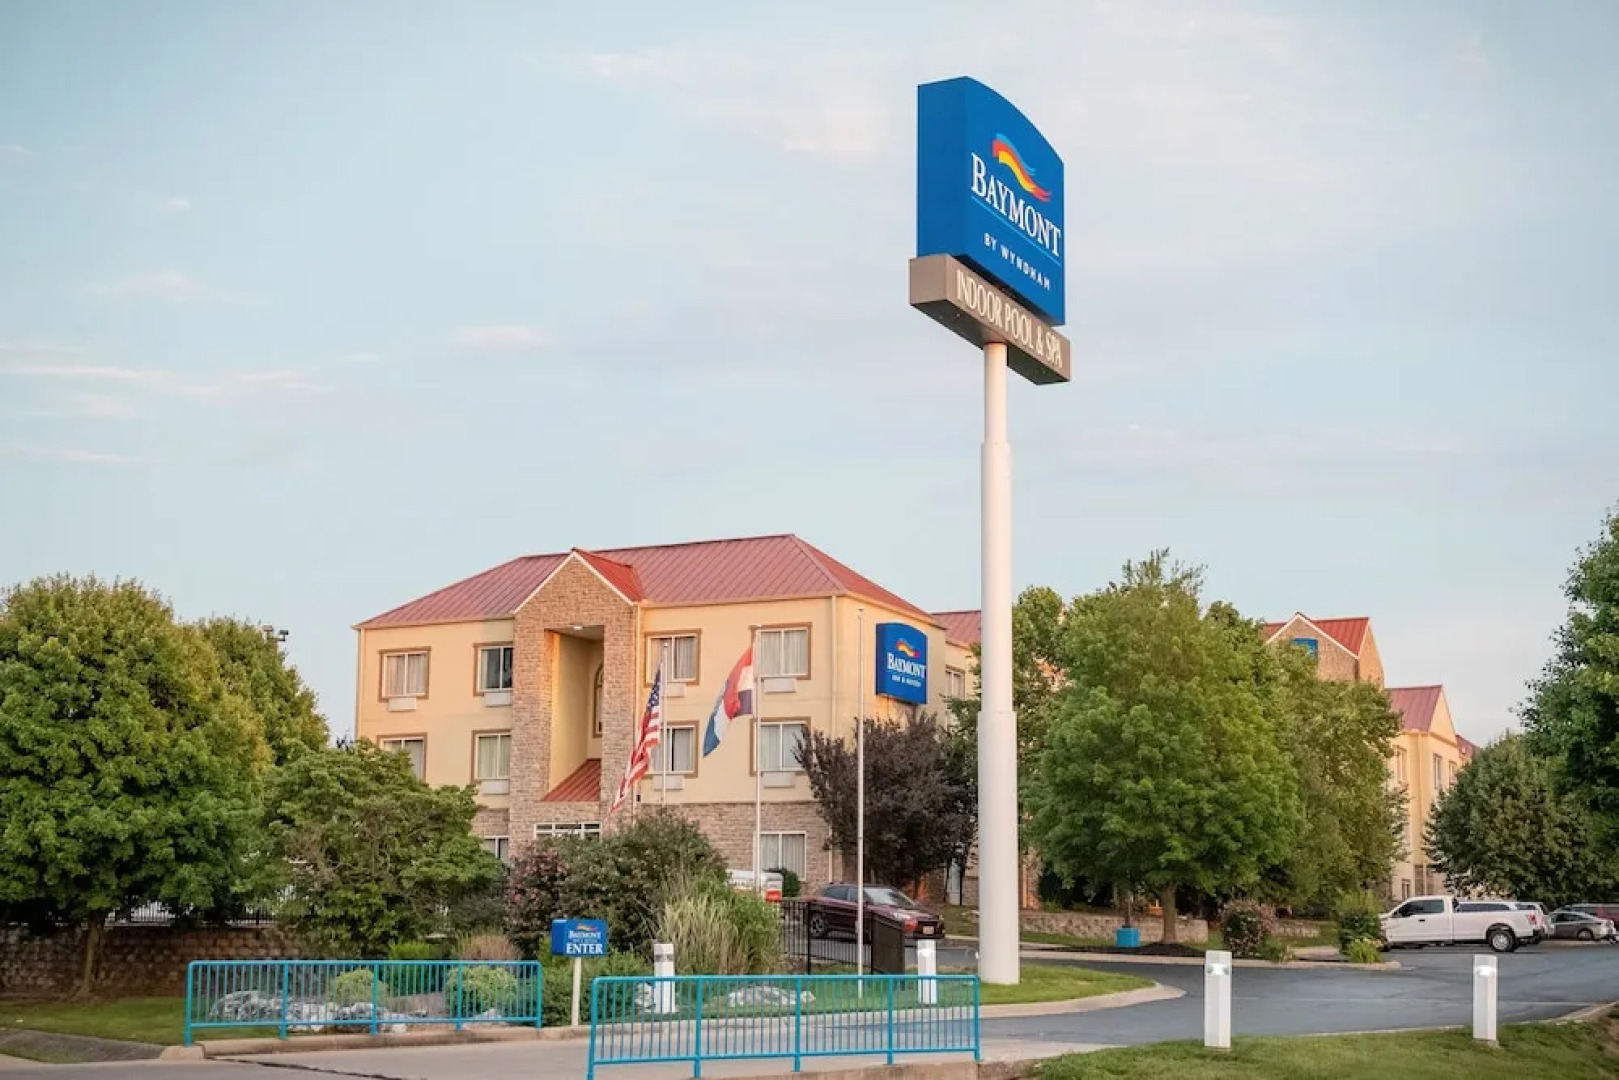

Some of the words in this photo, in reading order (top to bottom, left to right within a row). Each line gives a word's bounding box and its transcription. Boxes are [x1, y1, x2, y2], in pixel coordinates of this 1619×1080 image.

[971, 152, 1062, 256] BAYMONT
[984, 232, 997, 251] BY
[1001, 244, 1050, 290] WYNDHAM
[1004, 303, 1034, 349] POOL
[1036, 325, 1044, 355] &
[1045, 331, 1063, 369] SPA
[887, 652, 926, 679] BAYMONT
[566, 943, 603, 955] ENTER
